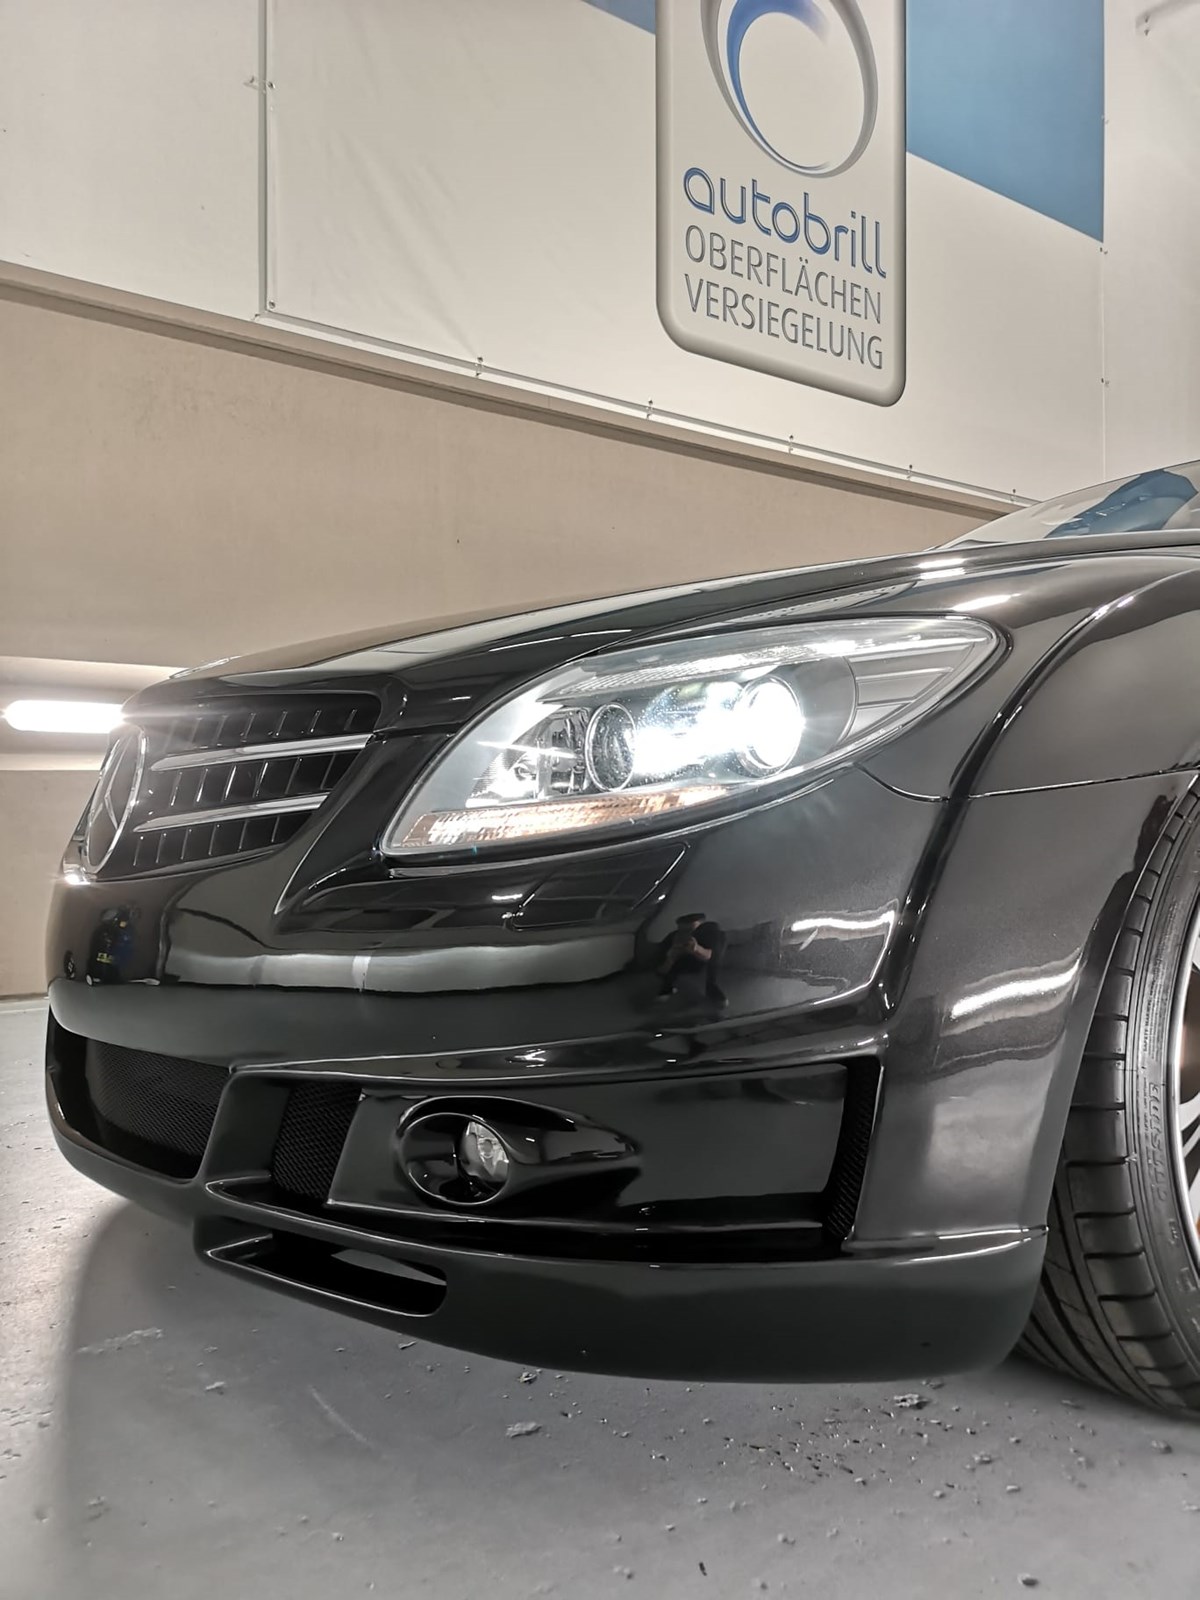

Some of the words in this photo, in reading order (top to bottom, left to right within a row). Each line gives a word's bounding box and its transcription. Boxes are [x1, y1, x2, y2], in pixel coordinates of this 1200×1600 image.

[683, 167, 887, 279] autobrill
[684, 273, 883, 370] VERSIEGELUNG
[685, 225, 881, 324] OBERFLÄCHEN
